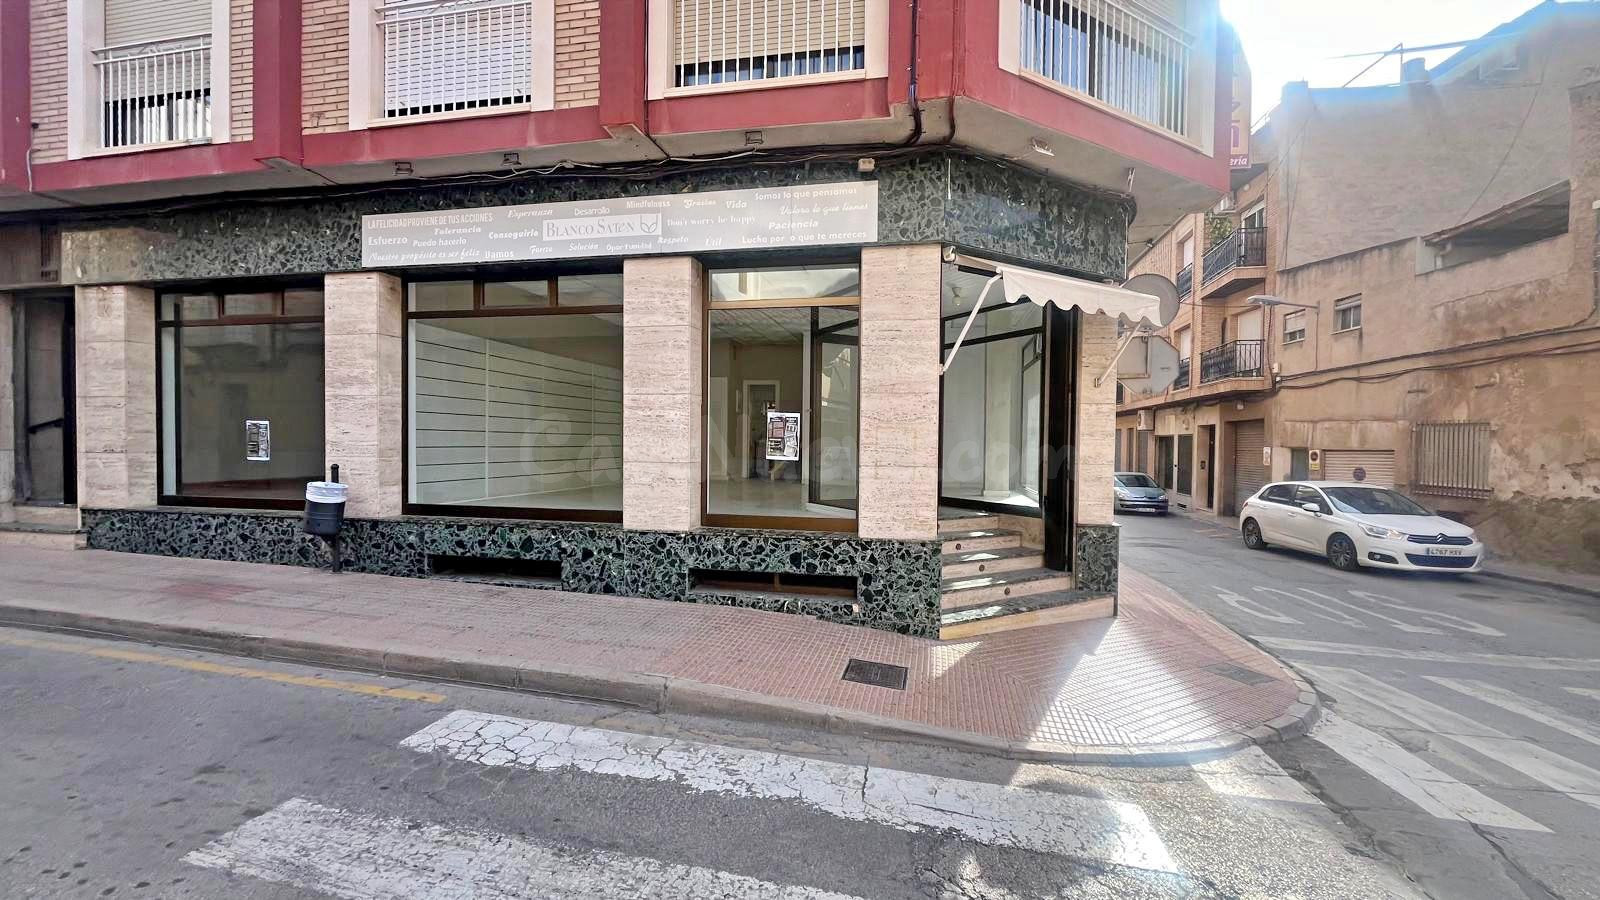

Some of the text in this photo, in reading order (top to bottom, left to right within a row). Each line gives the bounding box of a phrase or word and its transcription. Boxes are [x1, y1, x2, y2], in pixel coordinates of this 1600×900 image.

[755, 192, 780, 200] Somos
[794, 192, 810, 200] que
[812, 188, 857, 198] pensamos
[626, 200, 672, 208] Mindfulness
[726, 200, 748, 208] Vida
[507, 209, 553, 219] Esperanza
[574, 206, 610, 216] Desarrollo
[376, 220, 407, 228] FELICIDAD
[408, 217, 439, 227] PROVIENE
[440, 216, 446, 225] DE
[448, 215, 460, 224] TUS
[461, 213, 493, 223] ACCIONES
[730, 216, 756, 225] happy
[768, 220, 818, 230] Paciencia
[488, 229, 538, 240] Conseguirlo
[546, 222, 594, 238] BLANCO
[368, 236, 408, 246] Esfuerzo
[412, 238, 466, 247] Puedo hacerlo
[657, 236, 688, 244] Respeto
[770, 236, 784, 244] por
[798, 234, 814, 244] que
[829, 232, 867, 240] mereces
[460, 248, 480, 260] feliz
[529, 245, 553, 254] Fuerza
